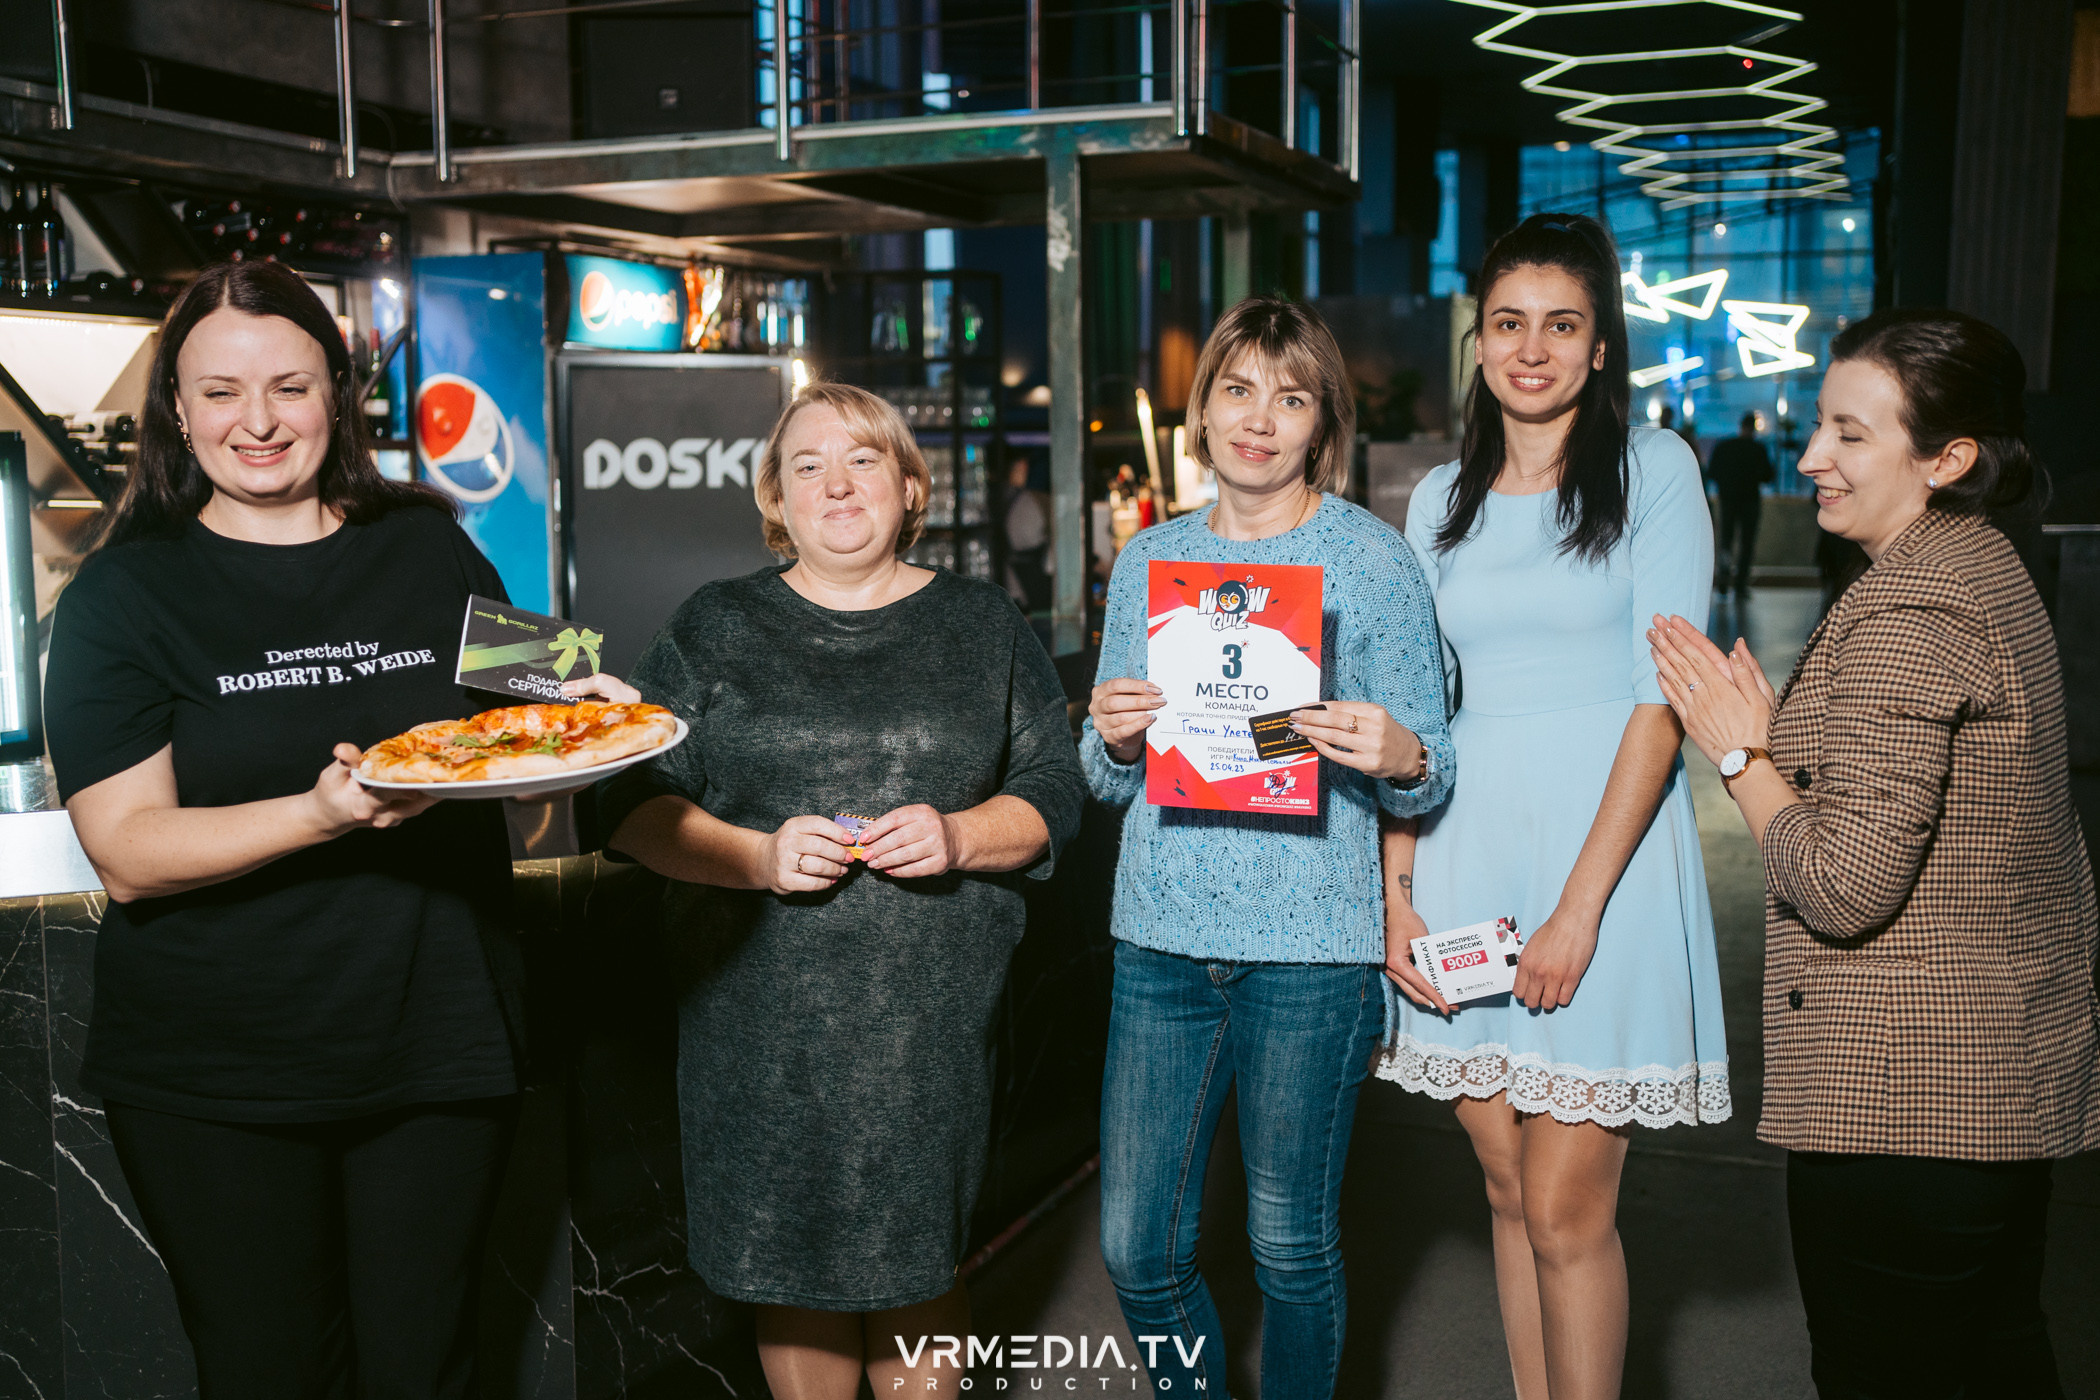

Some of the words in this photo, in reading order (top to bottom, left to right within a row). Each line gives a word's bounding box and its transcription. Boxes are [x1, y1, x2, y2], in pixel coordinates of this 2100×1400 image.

[613, 289, 679, 330] pepsi
[474, 610, 497, 620] GREEN
[508, 619, 539, 631] GORILLAZ
[1211, 610, 1250, 632] QUIZ
[264, 642, 354, 664] Derected
[354, 641, 379, 657] by
[1222, 643, 1243, 679] 3
[216, 666, 322, 695] ROBERT
[326, 665, 352, 684] B.
[352, 649, 436, 677] WEIDE
[526, 673, 563, 689] ПОДАРО
[508, 677, 585, 703] СЕРТИФИ
[1195, 682, 1269, 700] МЕСТО
[1176, 711, 1204, 719] КОТОРАЯ
[1205, 701, 1258, 712] КОМАНДА,
[1182, 719, 1215, 735] Грачи
[1222, 724, 1254, 739] Улете
[1207, 746, 1255, 754] ПОБЕДИТЕЛИ
[1210, 762, 1245, 773] 25.04.23
[1438, 940, 1483, 955] ФОТОСЕССИЮ
[1447, 933, 1481, 947] ЭКСПРЕСС-
[1420, 941, 1443, 996] ЕРТИФИКАТ
